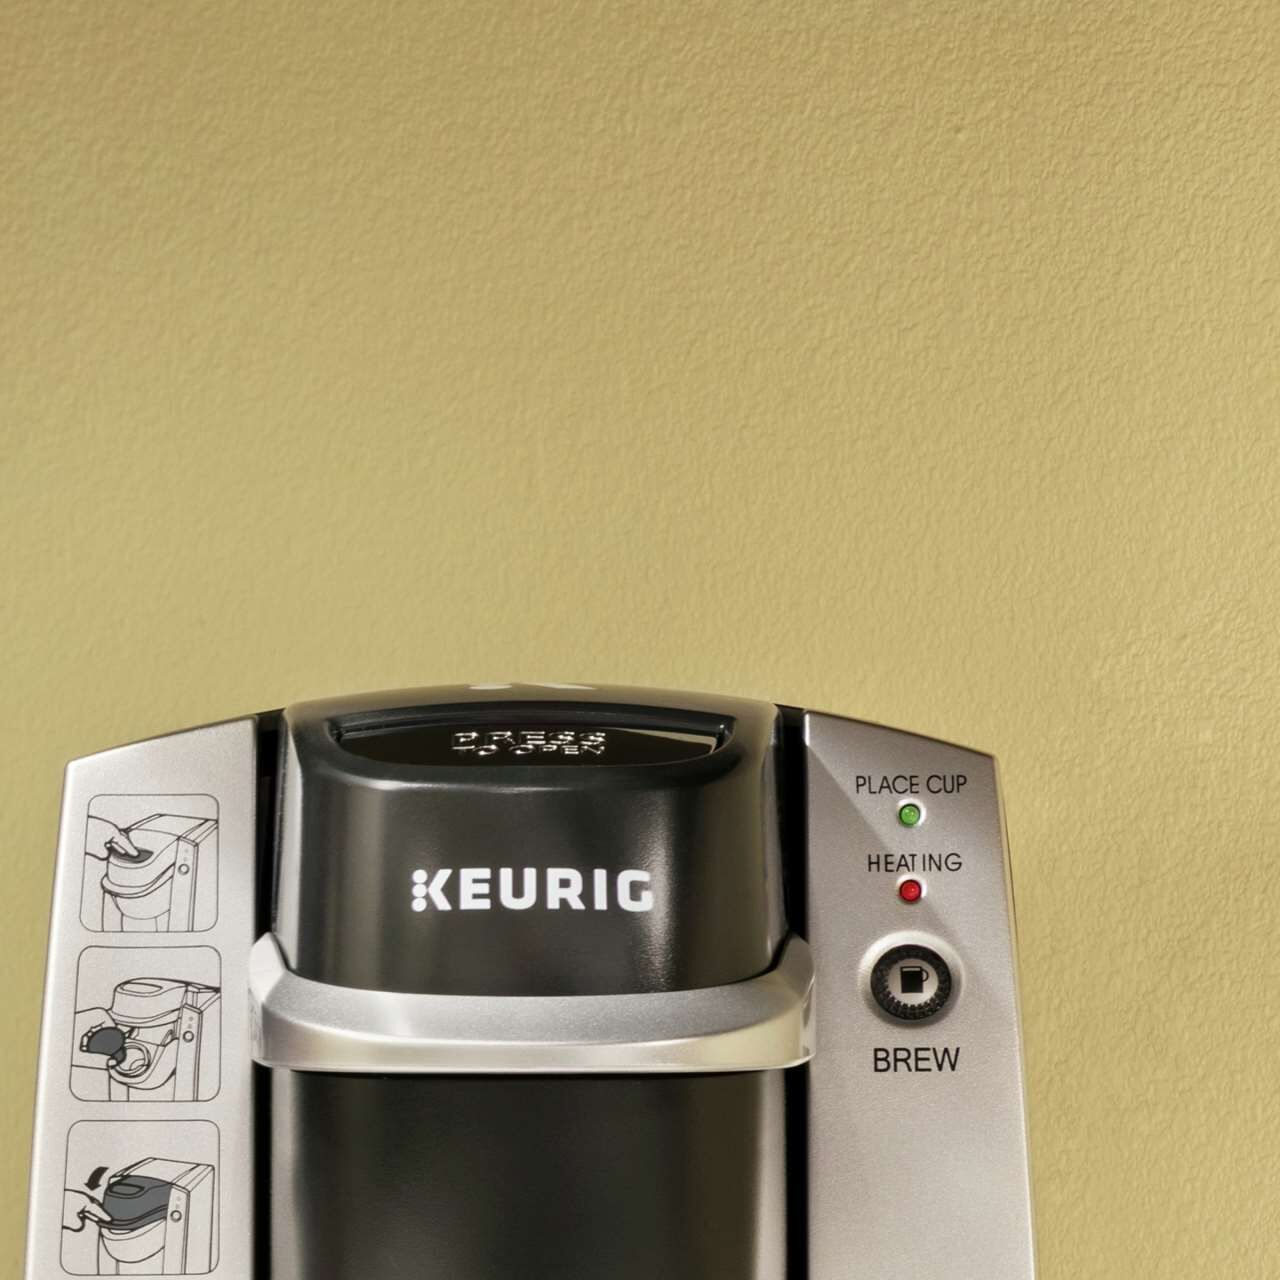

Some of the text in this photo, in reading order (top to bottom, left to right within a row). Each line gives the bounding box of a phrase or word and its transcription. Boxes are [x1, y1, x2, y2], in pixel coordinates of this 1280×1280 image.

[453, 731, 606, 746] PRESS
[452, 744, 605, 755] TO OPEN
[855, 774, 968, 794] PLACE CUP
[867, 852, 963, 873] HEATING
[411, 867, 654, 912] KEURIG
[873, 1047, 961, 1073] BREW
